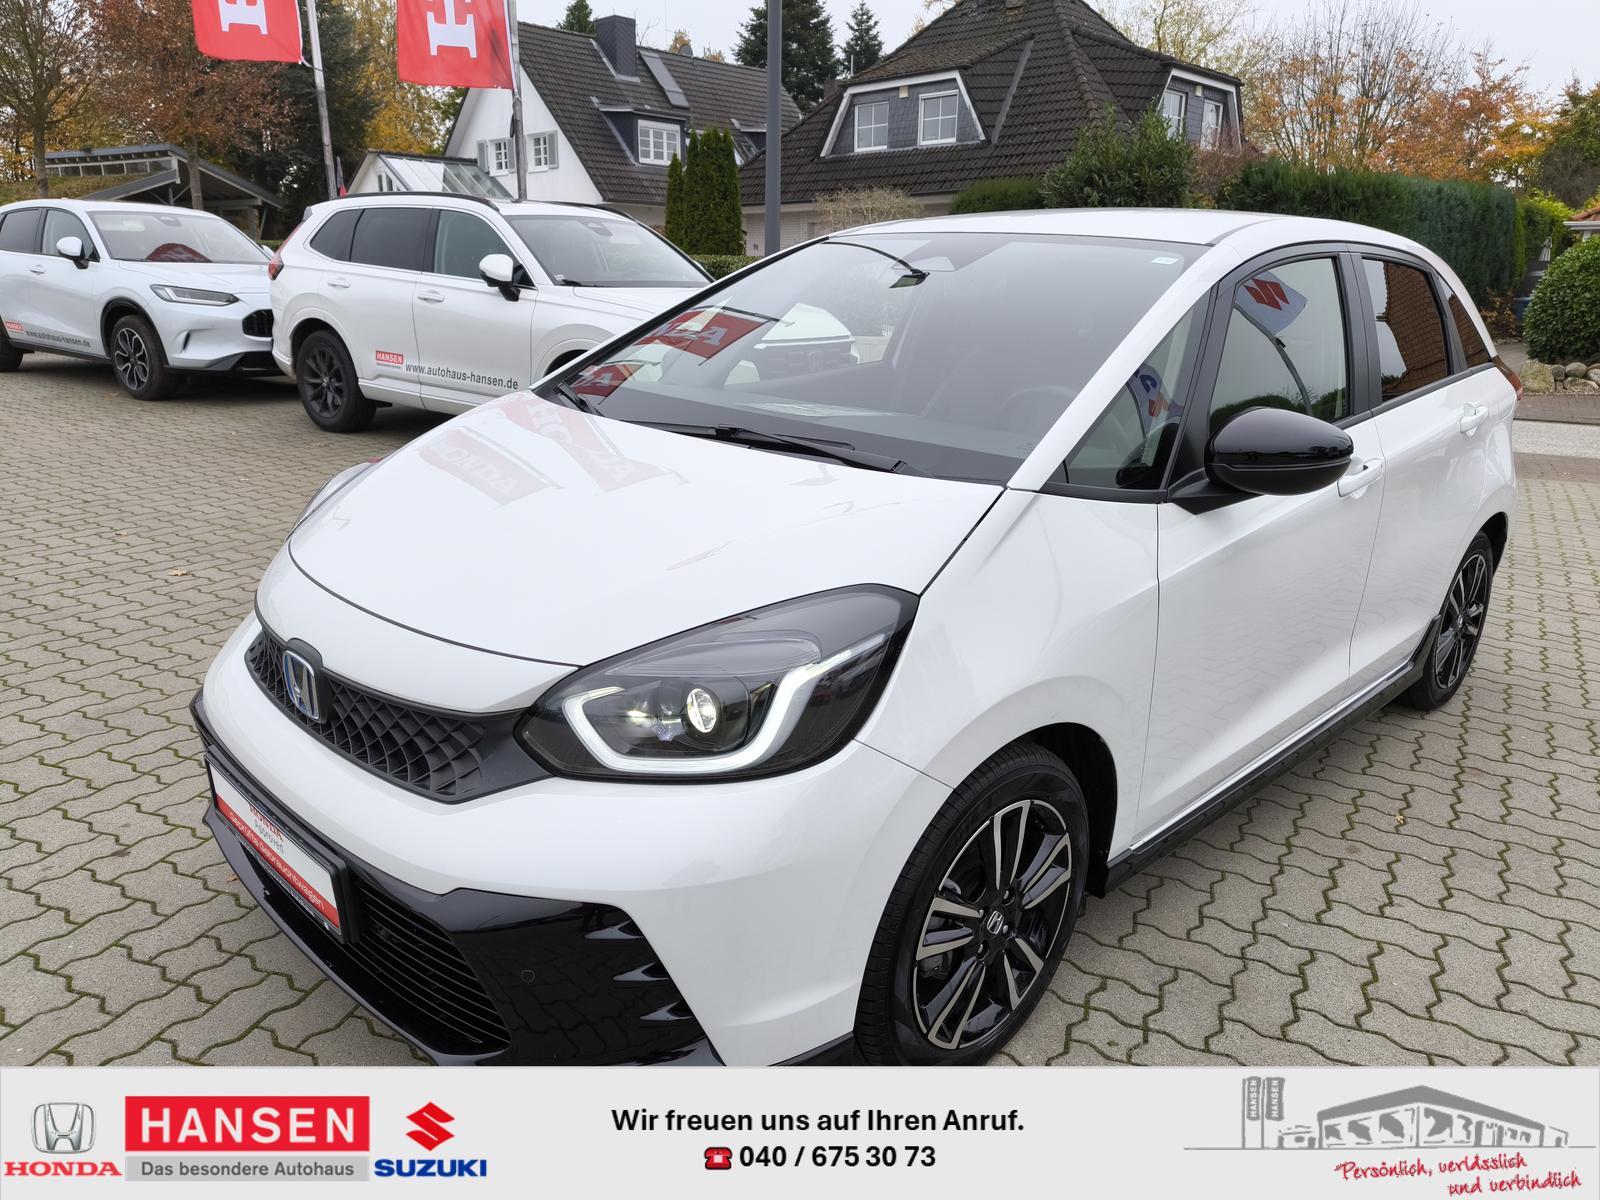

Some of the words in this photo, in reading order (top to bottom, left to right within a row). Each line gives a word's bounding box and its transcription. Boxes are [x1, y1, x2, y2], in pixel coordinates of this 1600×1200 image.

[377, 351, 402, 363] HANSEN
[405, 363, 519, 390] www.autohaus-hansen.de
[254, 818, 284, 854] Approved
[258, 841, 325, 911] Gebrauchtwagen
